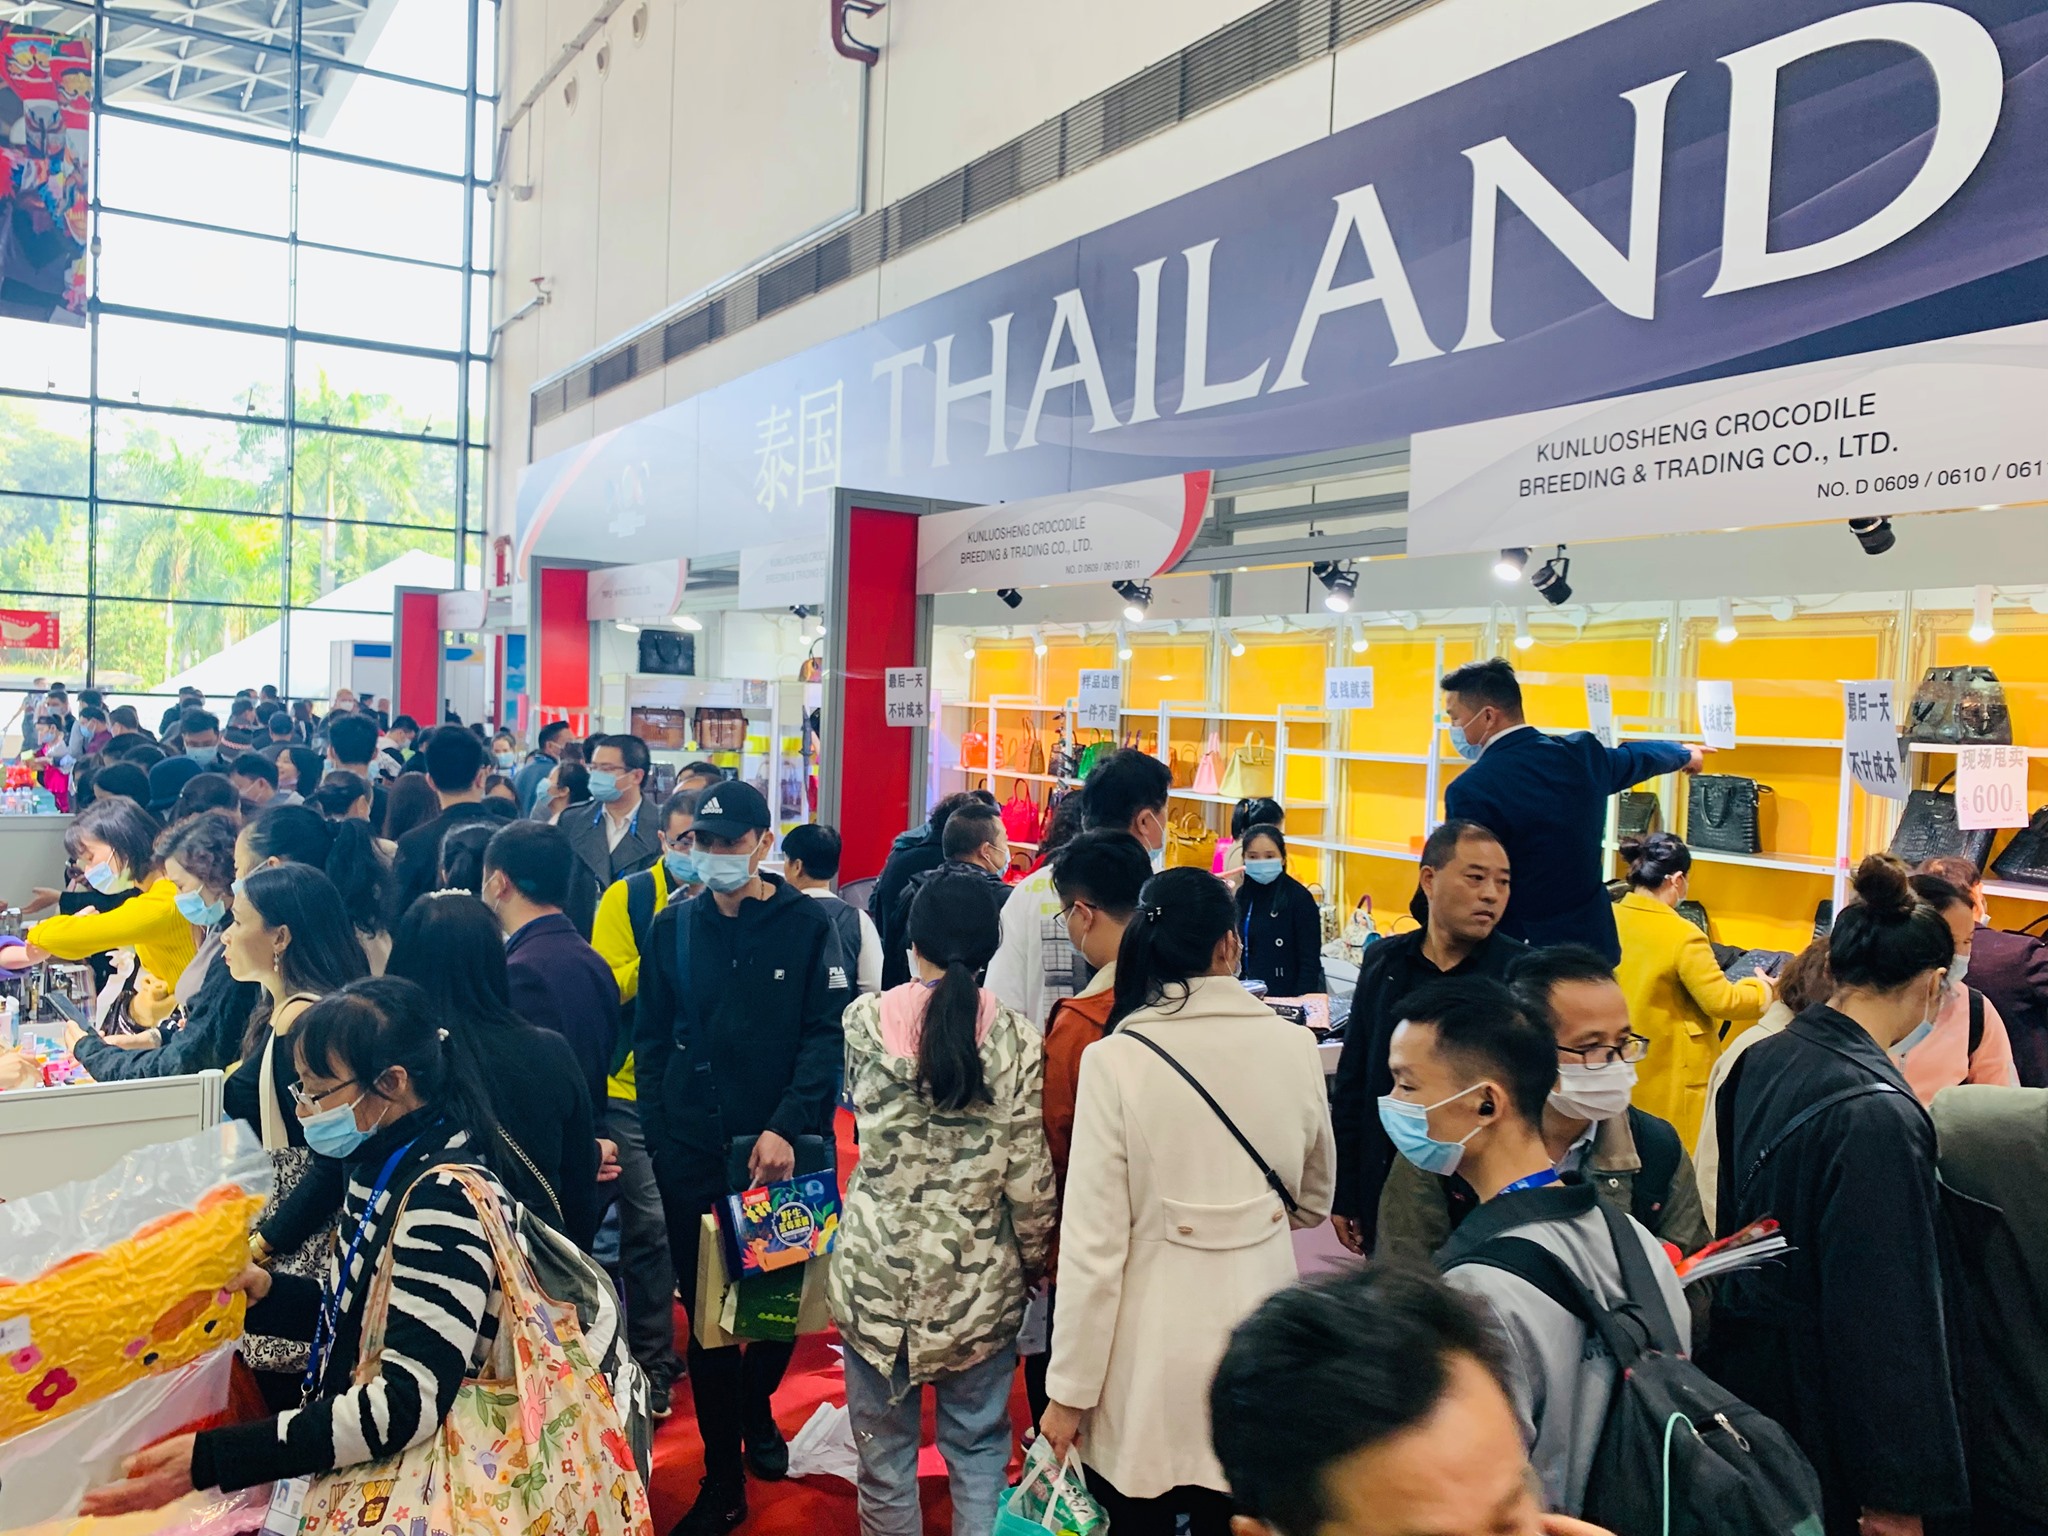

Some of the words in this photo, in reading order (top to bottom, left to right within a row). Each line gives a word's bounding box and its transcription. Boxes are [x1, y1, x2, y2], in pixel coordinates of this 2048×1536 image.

[872, 2, 2003, 477] THAILAND
[1537, 420, 1708, 462] KUNLUOSHENG
[1716, 393, 1876, 436] CROCODILE
[753, 379, 843, 512] 泰国
[1520, 466, 1625, 497] BREEDING
[1633, 465, 1646, 483] &
[1654, 448, 1764, 481] TRADING
[1773, 441, 1829, 467] CO.,
[1839, 431, 1899, 459] LTD.
[1817, 481, 1850, 498] NO.
[1856, 479, 1869, 494] D
[1874, 474, 1920, 492] 0609
[1937, 466, 1987, 486] 0610
[2006, 460, 2048, 479] 061
[967, 524, 1030, 544] KUNLUOSHENG
[1032, 516, 1086, 535] CROCODILE
[960, 549, 1001, 564] BREEDING
[1011, 543, 1049, 558] TRADING
[889, 673, 923, 688] 最后一天
[1081, 674, 1120, 690] 样品出售
[888, 701, 924, 718] 不计成本
[1848, 692, 1890, 722] 最后一天
[1849, 750, 1897, 784] 不计成本
[1962, 747, 2024, 771] 现场甩卖
[1972, 783, 2013, 813] 600
[828, 966, 845, 976] FILA
